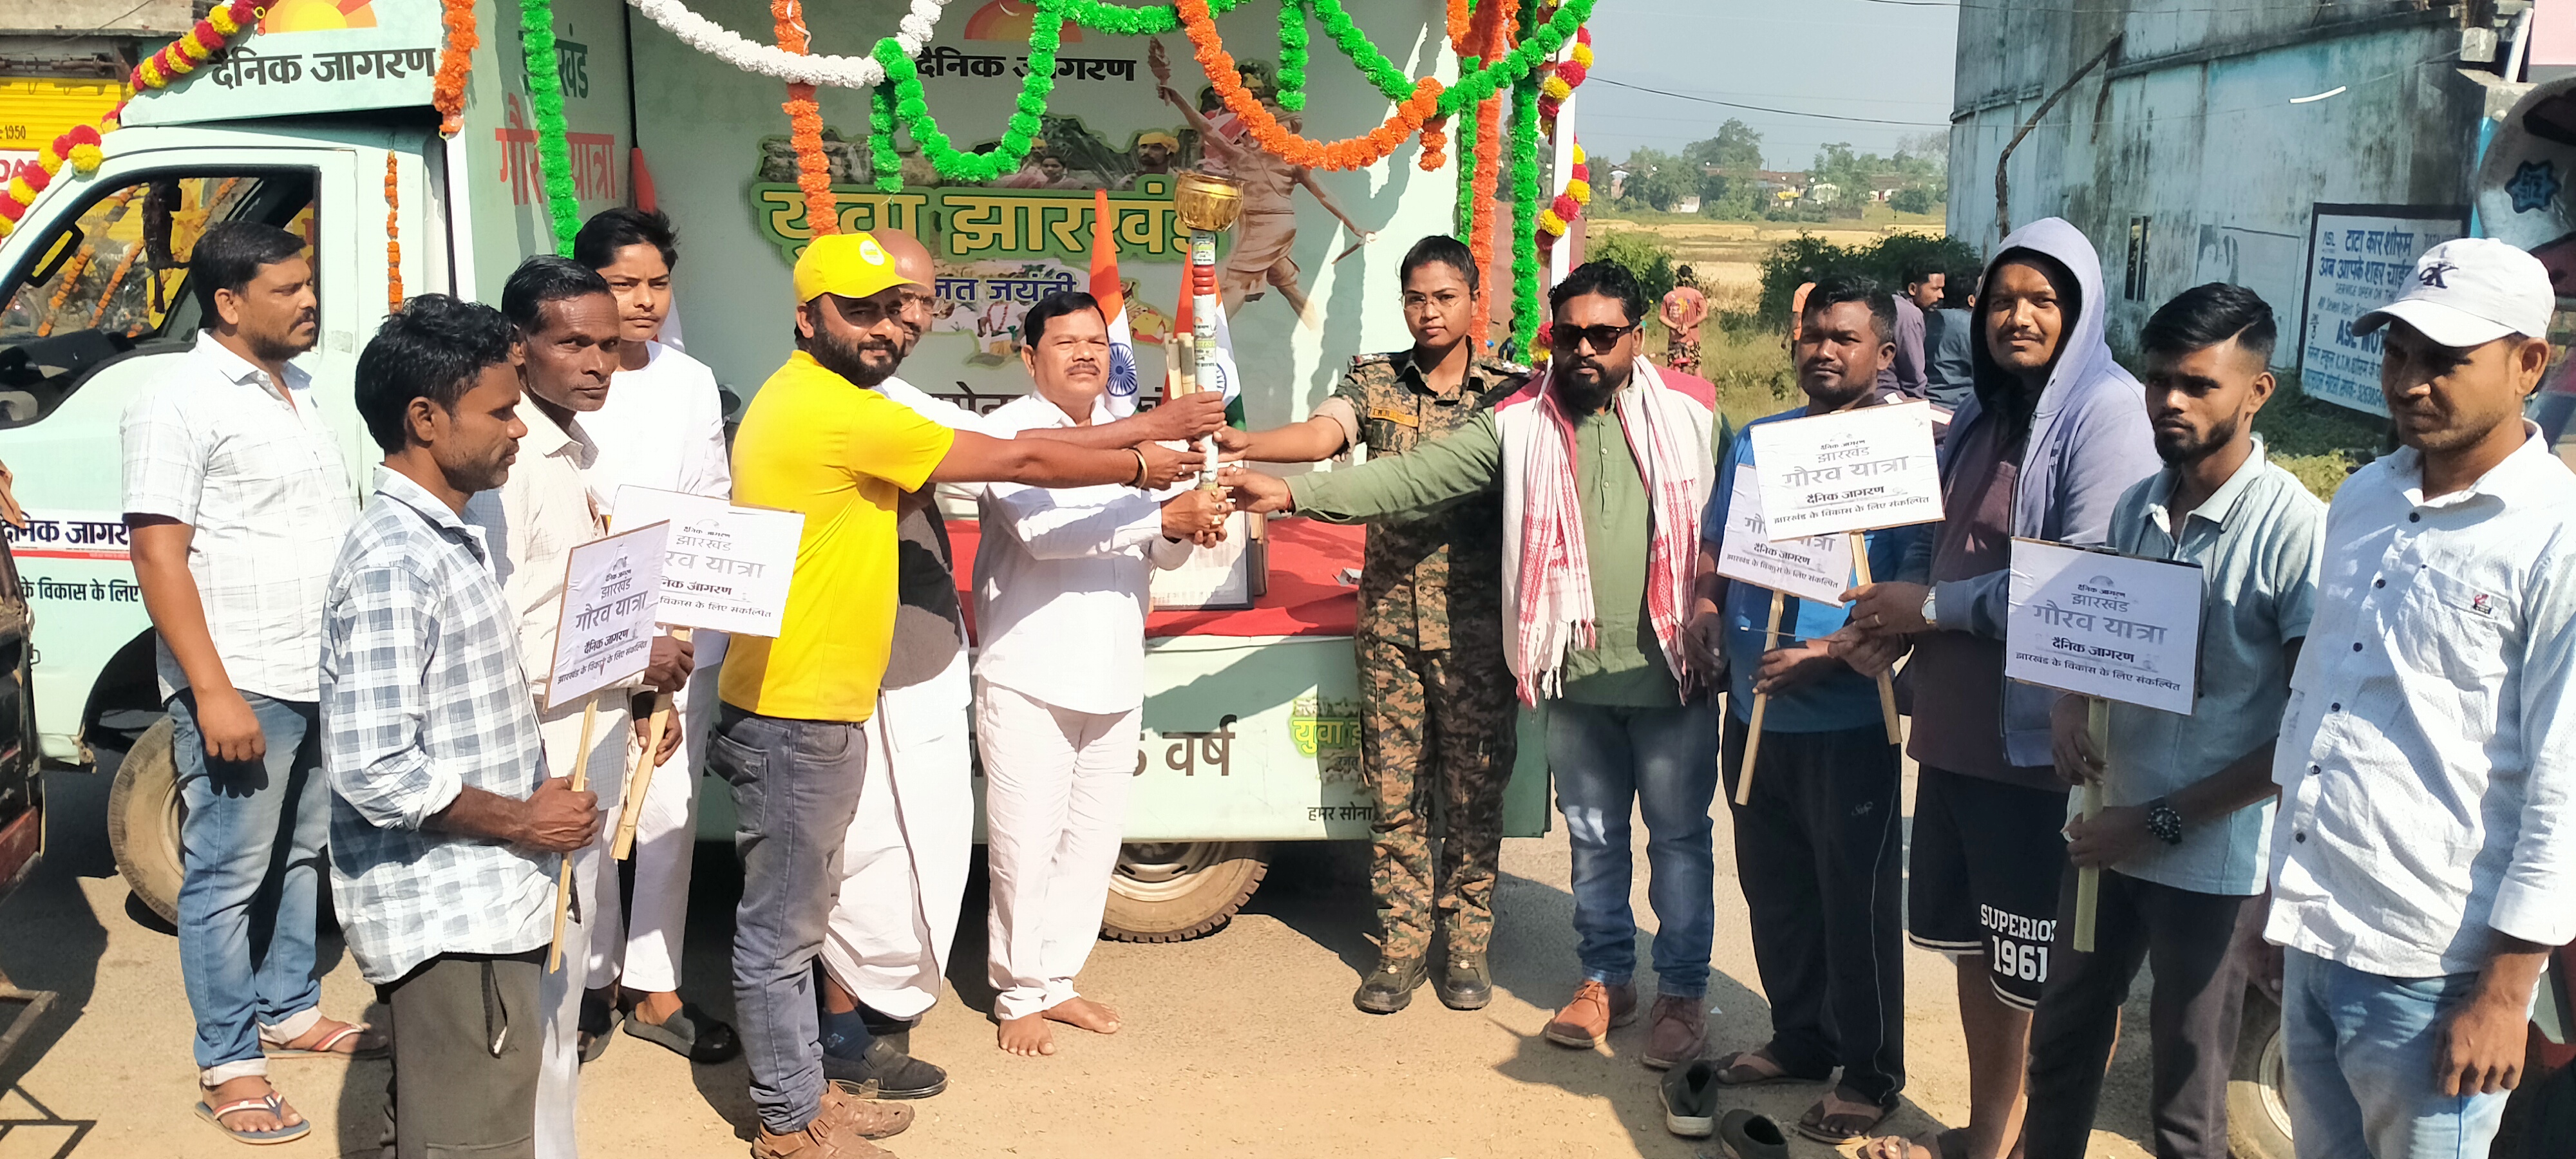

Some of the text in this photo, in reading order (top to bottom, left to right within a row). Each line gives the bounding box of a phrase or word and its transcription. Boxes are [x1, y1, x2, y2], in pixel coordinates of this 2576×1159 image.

[310, 48, 436, 82] जागरण
[914, 46, 1007, 78] दैनिक
[5, 124, 26, 140] 1950
[2345, 229, 2365, 252] टाटा
[2366, 231, 2384, 256] कार
[2318, 256, 2336, 278] अब
[2337, 256, 2364, 280] आपके
[2364, 259, 2386, 286] शहर
[1815, 445, 1870, 463] झारखंड
[1782, 456, 1909, 487] गौरव यात्रा
[1806, 485, 1884, 504] दैनिक जागरण
[1810, 511, 1819, 519] के
[1855, 504, 1864, 513] के
[1868, 502, 1886, 511] लिए
[1889, 496, 1929, 508] संकल्पित
[676, 534, 733, 551] झारखंड
[1754, 542, 1811, 565] दैनिक जागरण
[706, 556, 766, 579] यात्रा
[1793, 569, 1807, 580] लिए
[1808, 574, 1839, 589] संकल्पित
[37, 577, 88, 601] विकास
[90, 578, 106, 601] के
[108, 580, 140, 602] लिए
[601, 576, 632, 599] झारखंड
[687, 581, 732, 595] जागरण
[2078, 584, 2126, 598] दैनिक जागरण
[575, 590, 648, 632] गौरव यात्रा
[708, 601, 728, 612] लिए
[731, 605, 772, 617] संकल्पित
[2071, 593, 2130, 612] झारखंड
[2032, 599, 2168, 645] गौरव यात्रा
[584, 628, 630, 654] दैनिक जागरण
[2052, 636, 2135, 663] दैनिक जागरण
[557, 668, 580, 684] झारखंड
[580, 664, 587, 675] के
[607, 654, 614, 664] के
[614, 650, 625, 661] लिए
[625, 640, 648, 655] संकल्पित
[2016, 652, 2181, 692] झारखंड के विकास के लिए संकल्पित
[1161, 714, 1239, 777] वर्ष
[1293, 719, 1344, 754] युवा
[1307, 806, 1336, 822] हमर
[1992, 934, 2048, 983] 1961
